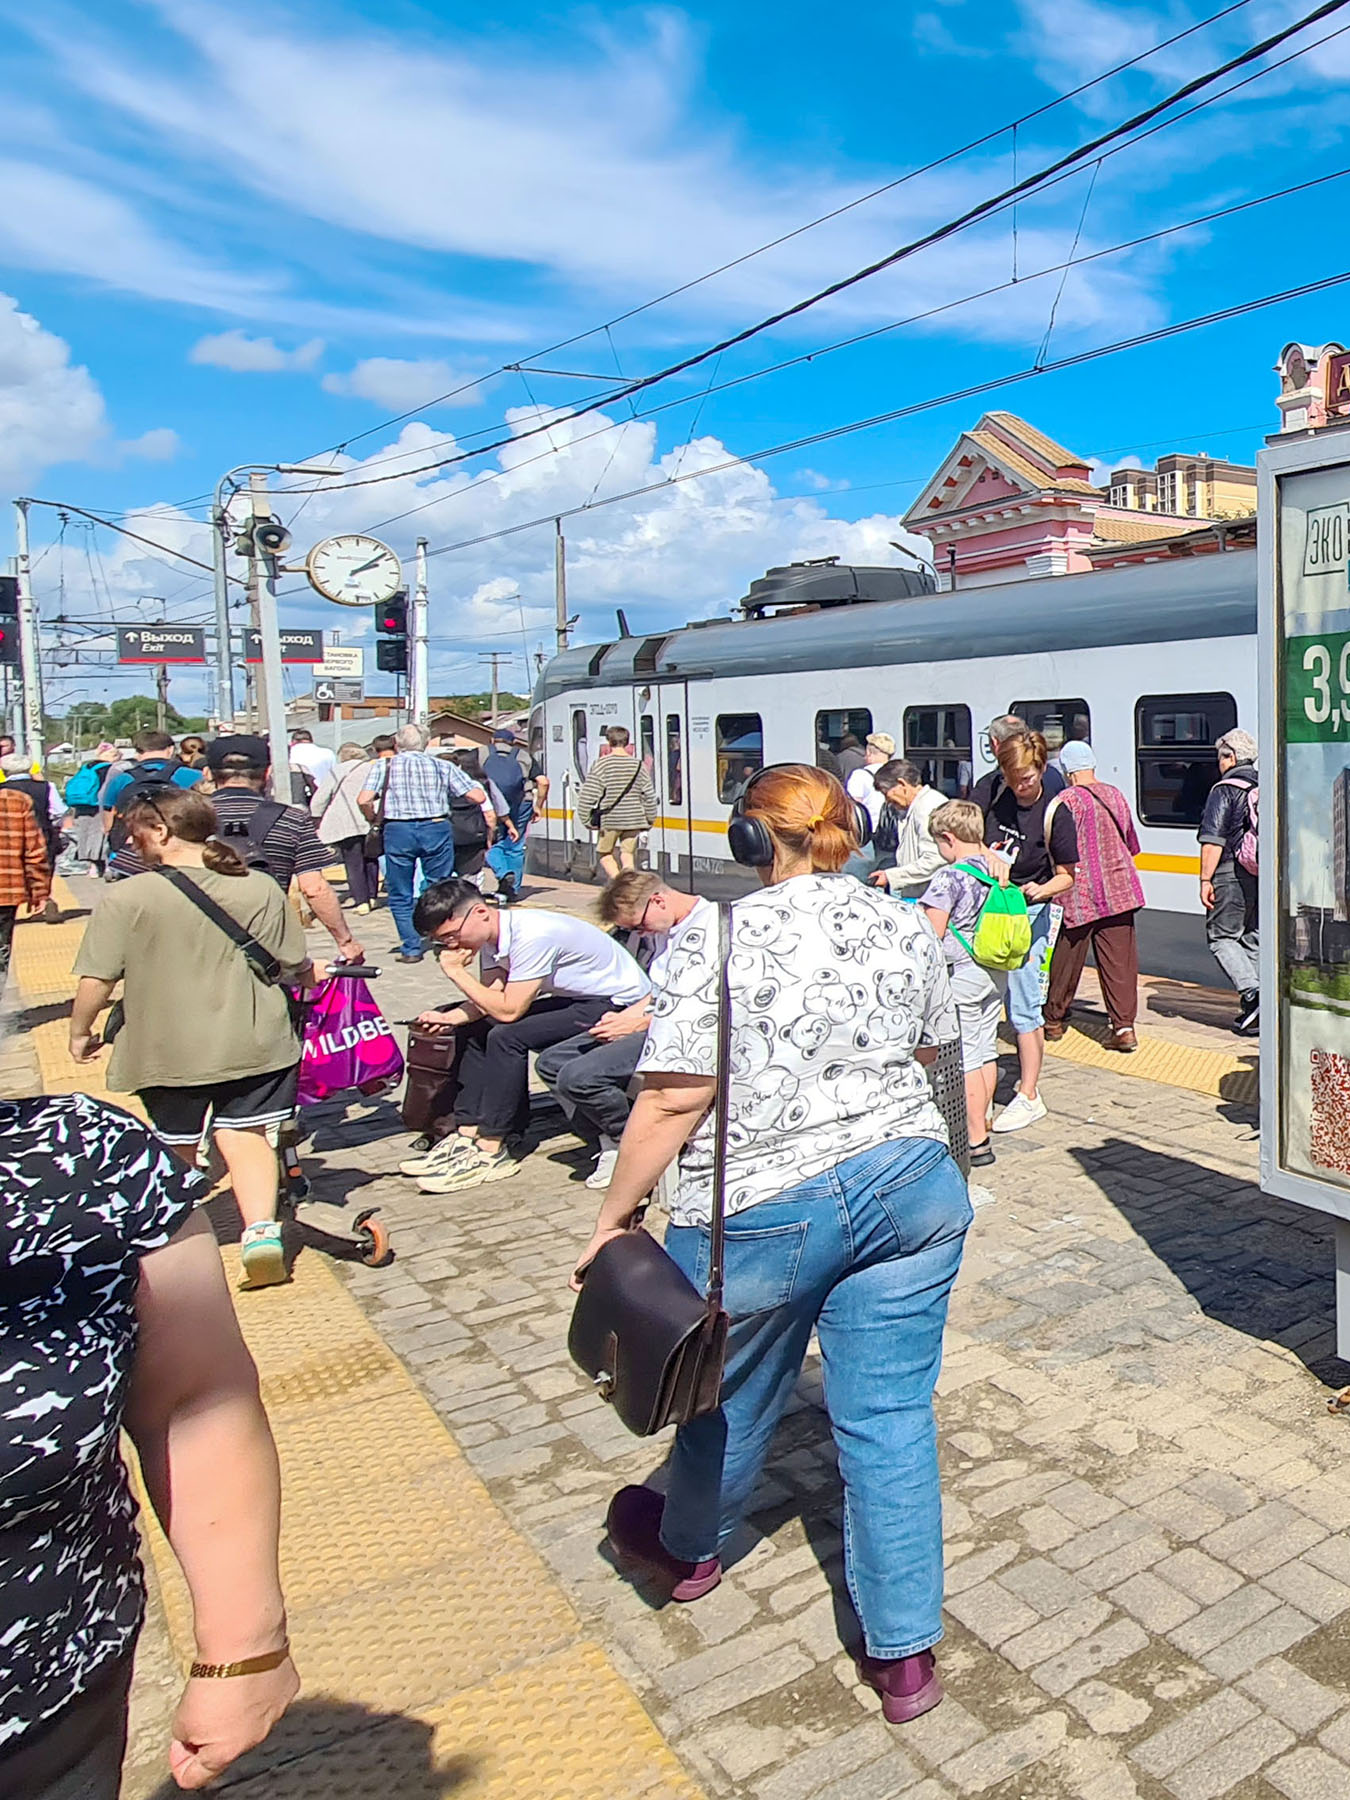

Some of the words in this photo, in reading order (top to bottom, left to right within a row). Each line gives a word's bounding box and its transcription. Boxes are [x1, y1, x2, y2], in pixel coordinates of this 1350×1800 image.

[1310, 515, 1342, 564] ЭКО
[142, 643, 165, 652] Exit
[302, 1016, 391, 1060] WILDBE
